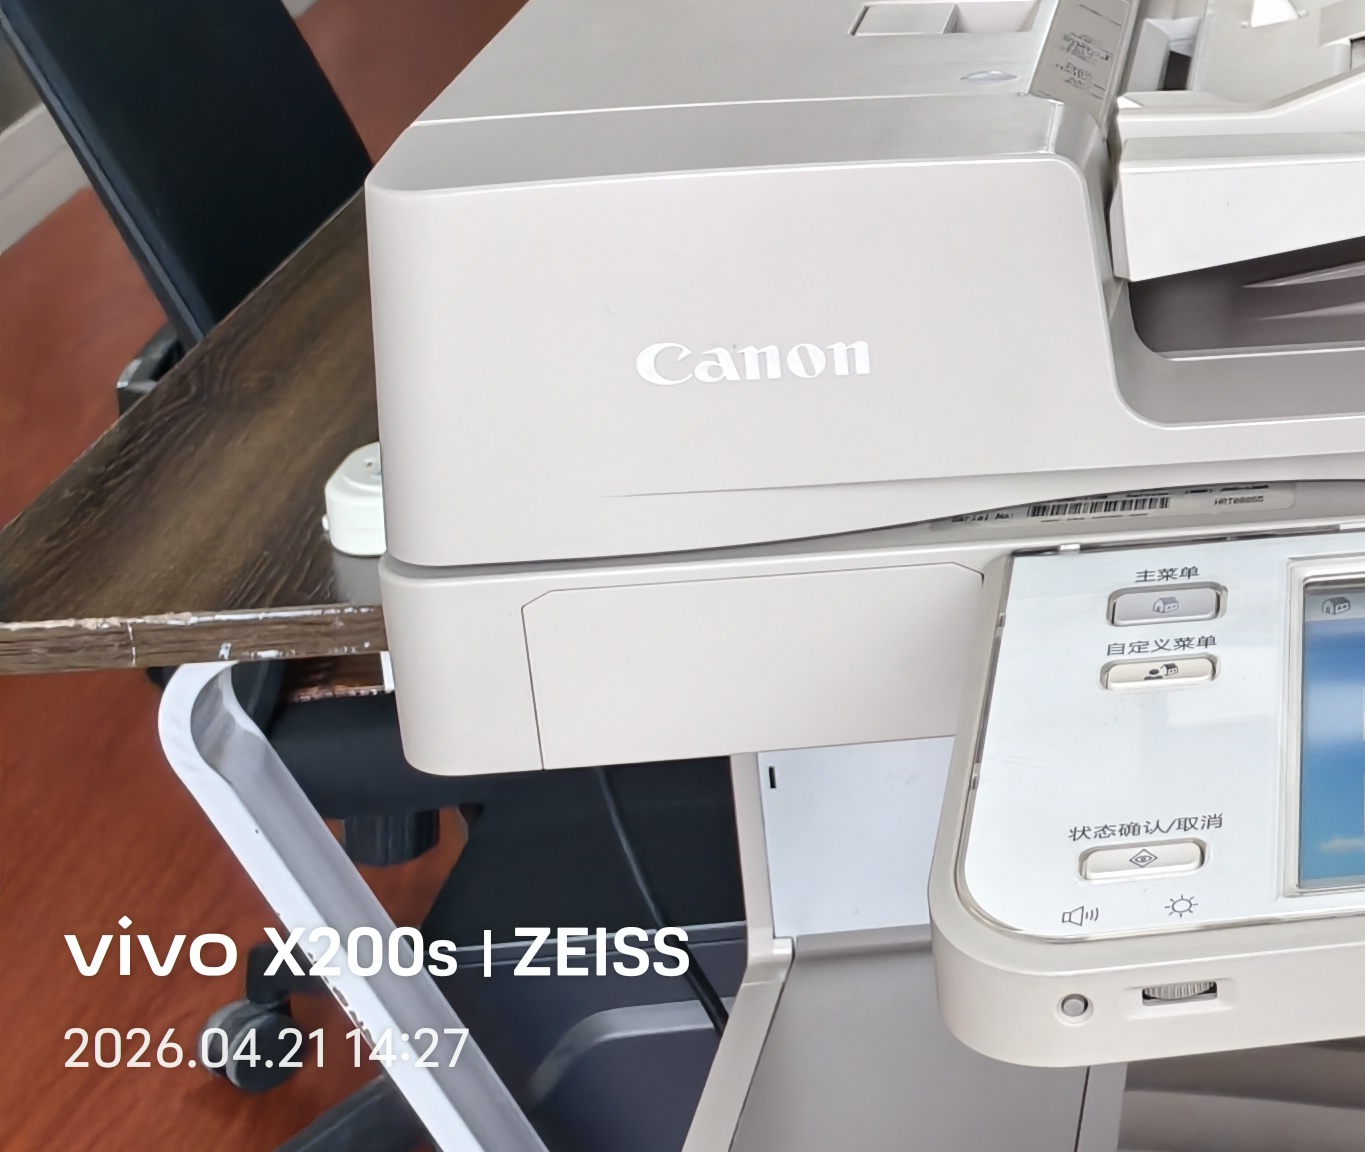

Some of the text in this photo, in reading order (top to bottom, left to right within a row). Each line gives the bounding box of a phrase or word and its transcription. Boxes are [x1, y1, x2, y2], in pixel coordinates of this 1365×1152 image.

[636, 339, 872, 386] Canon
[1135, 566, 1200, 583] 主菜单
[1106, 634, 1218, 656] 自定义菜单
[1068, 812, 1224, 843] 状态确认/取消
